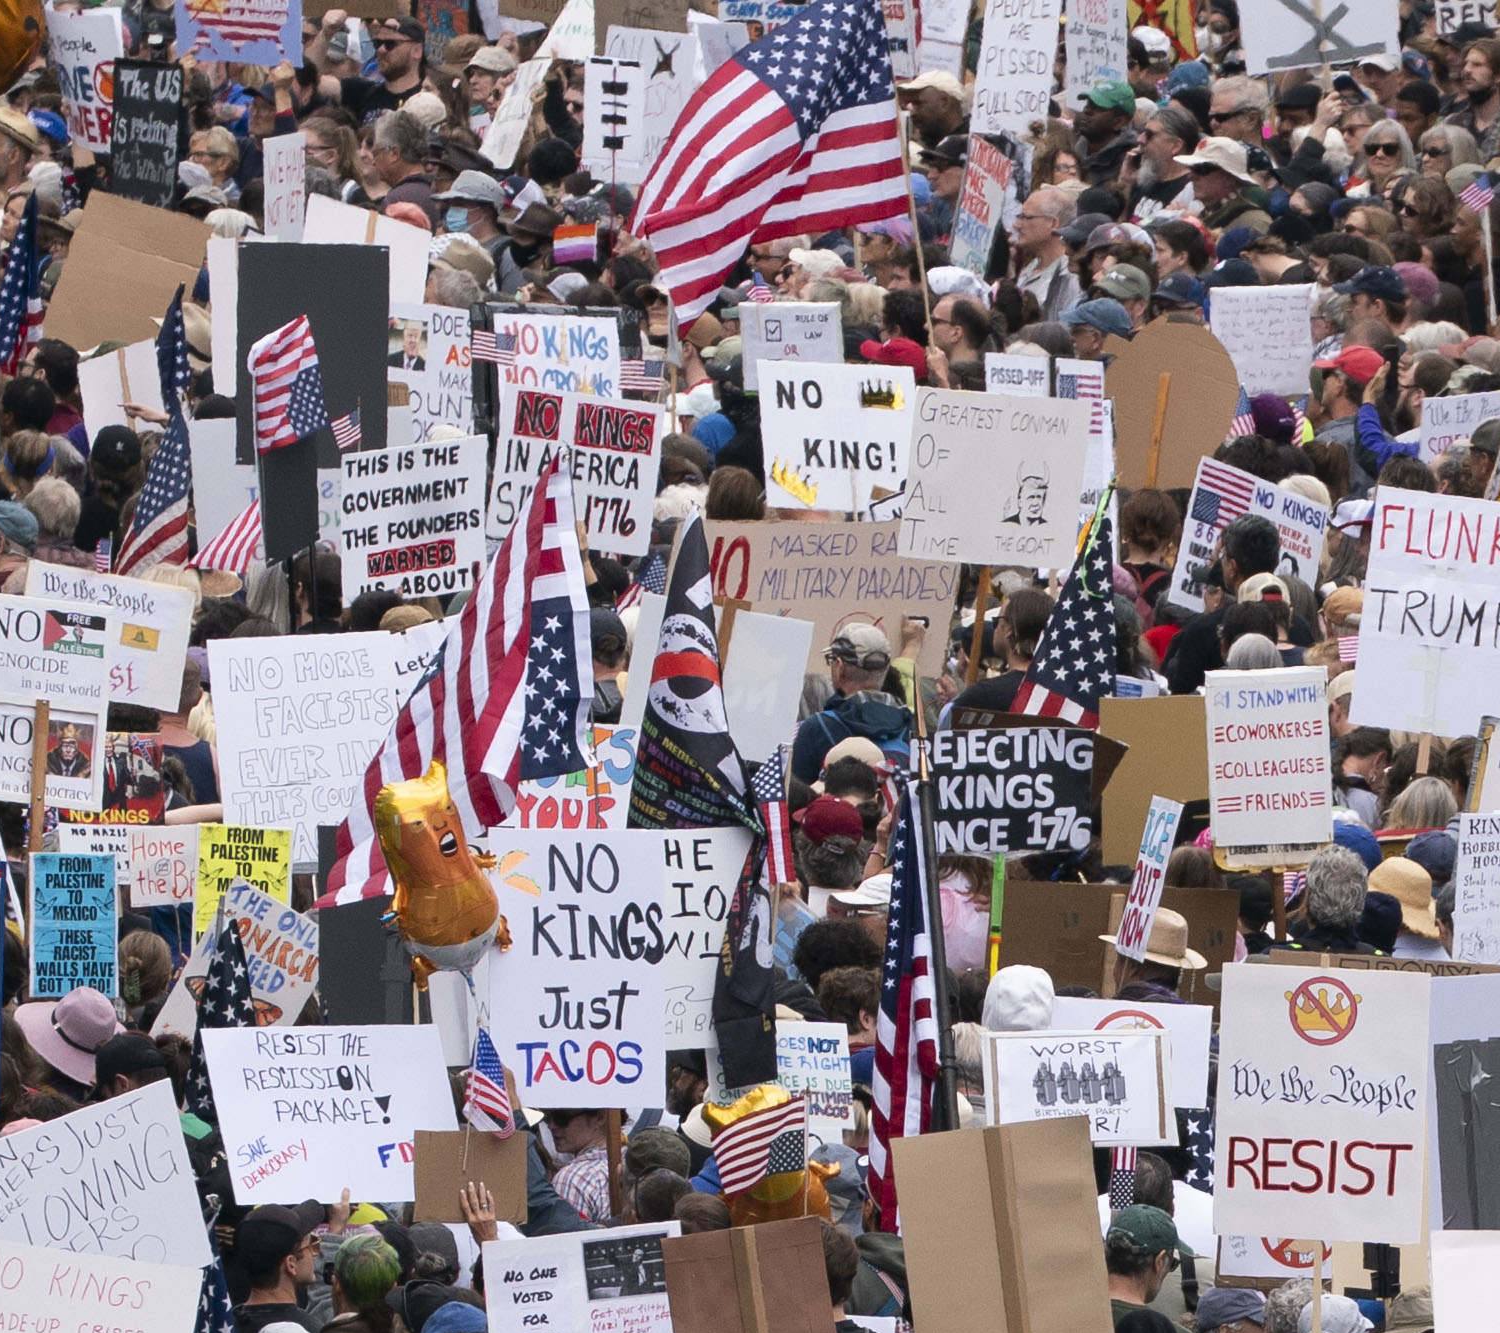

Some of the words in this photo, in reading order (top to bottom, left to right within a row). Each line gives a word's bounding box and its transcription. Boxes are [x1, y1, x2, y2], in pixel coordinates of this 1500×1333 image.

[984, 45, 1047, 77] PISSED
[989, 366, 1045, 385] PISSED-OFF
[514, 391, 559, 438] NO
[575, 402, 655, 455] KINGS
[920, 392, 1003, 431] GREATEST
[1010, 410, 1069, 436] CONMAN
[802, 437, 898, 476] KING!
[345, 475, 470, 513] GOVERNMENT
[343, 521, 380, 548] THE
[385, 510, 481, 545] FOUNDERS
[43, 572, 69, 596] We
[72, 582, 97, 601] the
[97, 583, 156, 617] People
[66, 614, 92, 626] FREE
[53, 643, 100, 657] PALESTINE
[1224, 719, 1313, 744] COWORKERS
[1245, 789, 1308, 813] FRIENDS
[539, 980, 641, 1033] Just
[516, 1039, 644, 1088] TACOS
[1226, 1134, 1413, 1198] RESIST
[512, 1291, 553, 1304] VOTED
